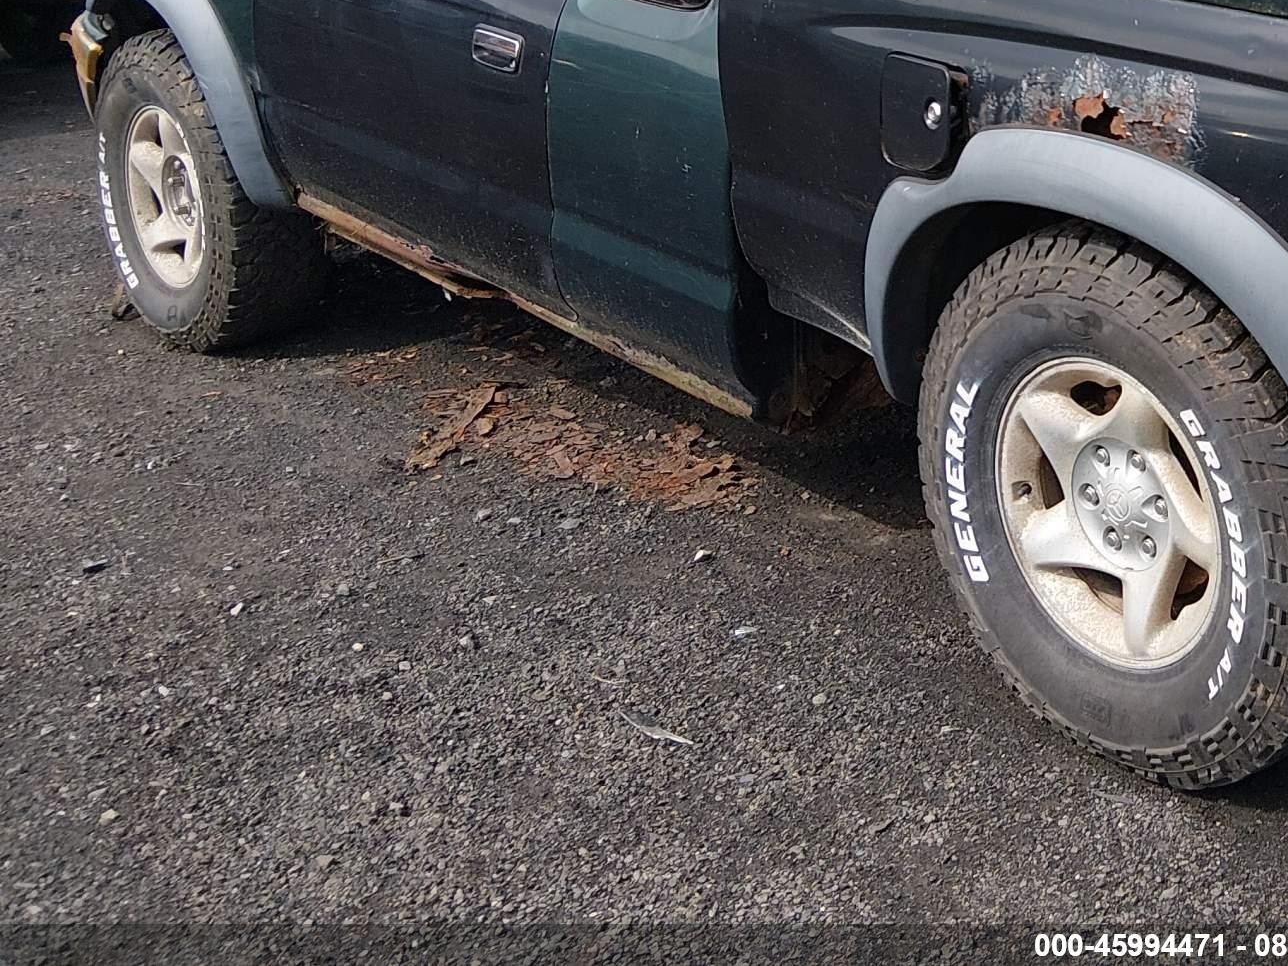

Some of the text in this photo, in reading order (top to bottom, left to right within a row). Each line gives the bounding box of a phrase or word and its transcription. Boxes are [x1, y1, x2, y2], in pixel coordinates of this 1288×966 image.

[944, 381, 990, 583] GENERAL
[1178, 408, 1249, 701] GRABBER A/T
